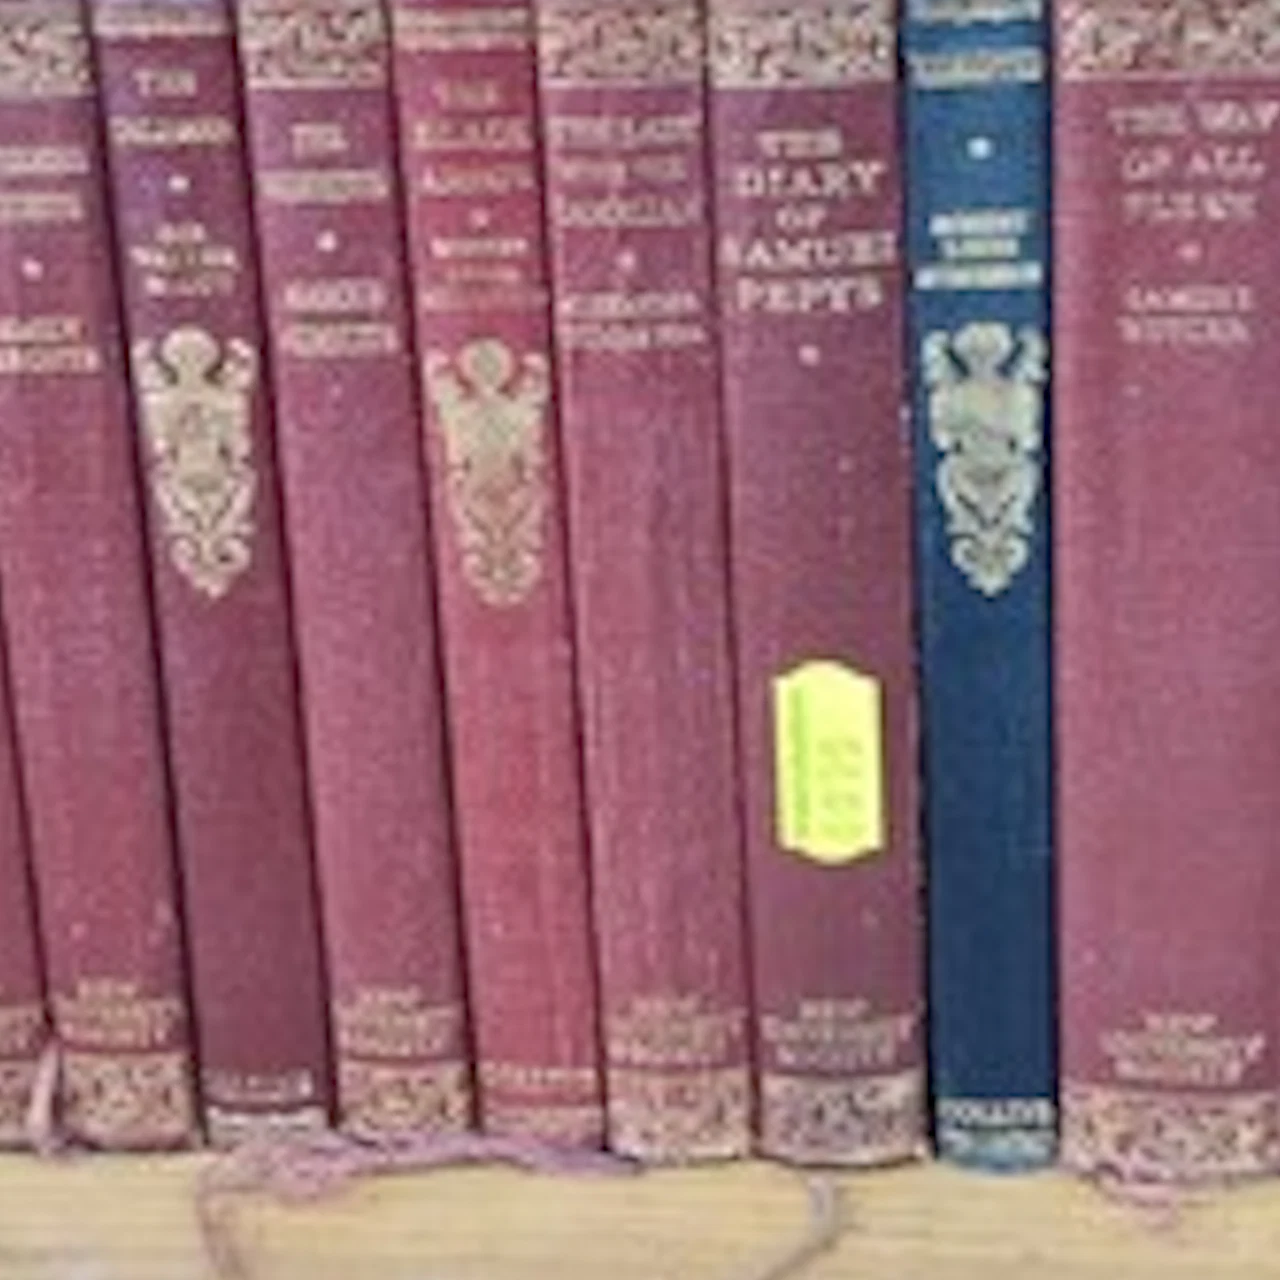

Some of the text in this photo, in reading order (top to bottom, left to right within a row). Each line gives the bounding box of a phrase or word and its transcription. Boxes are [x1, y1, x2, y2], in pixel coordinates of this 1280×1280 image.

[758, 130, 842, 157] THE
[736, 161, 885, 197] DIARY
[1122, 147, 1266, 179] OF ALL
[776, 206, 828, 232] OF
[736, 276, 884, 313] PEPYS
